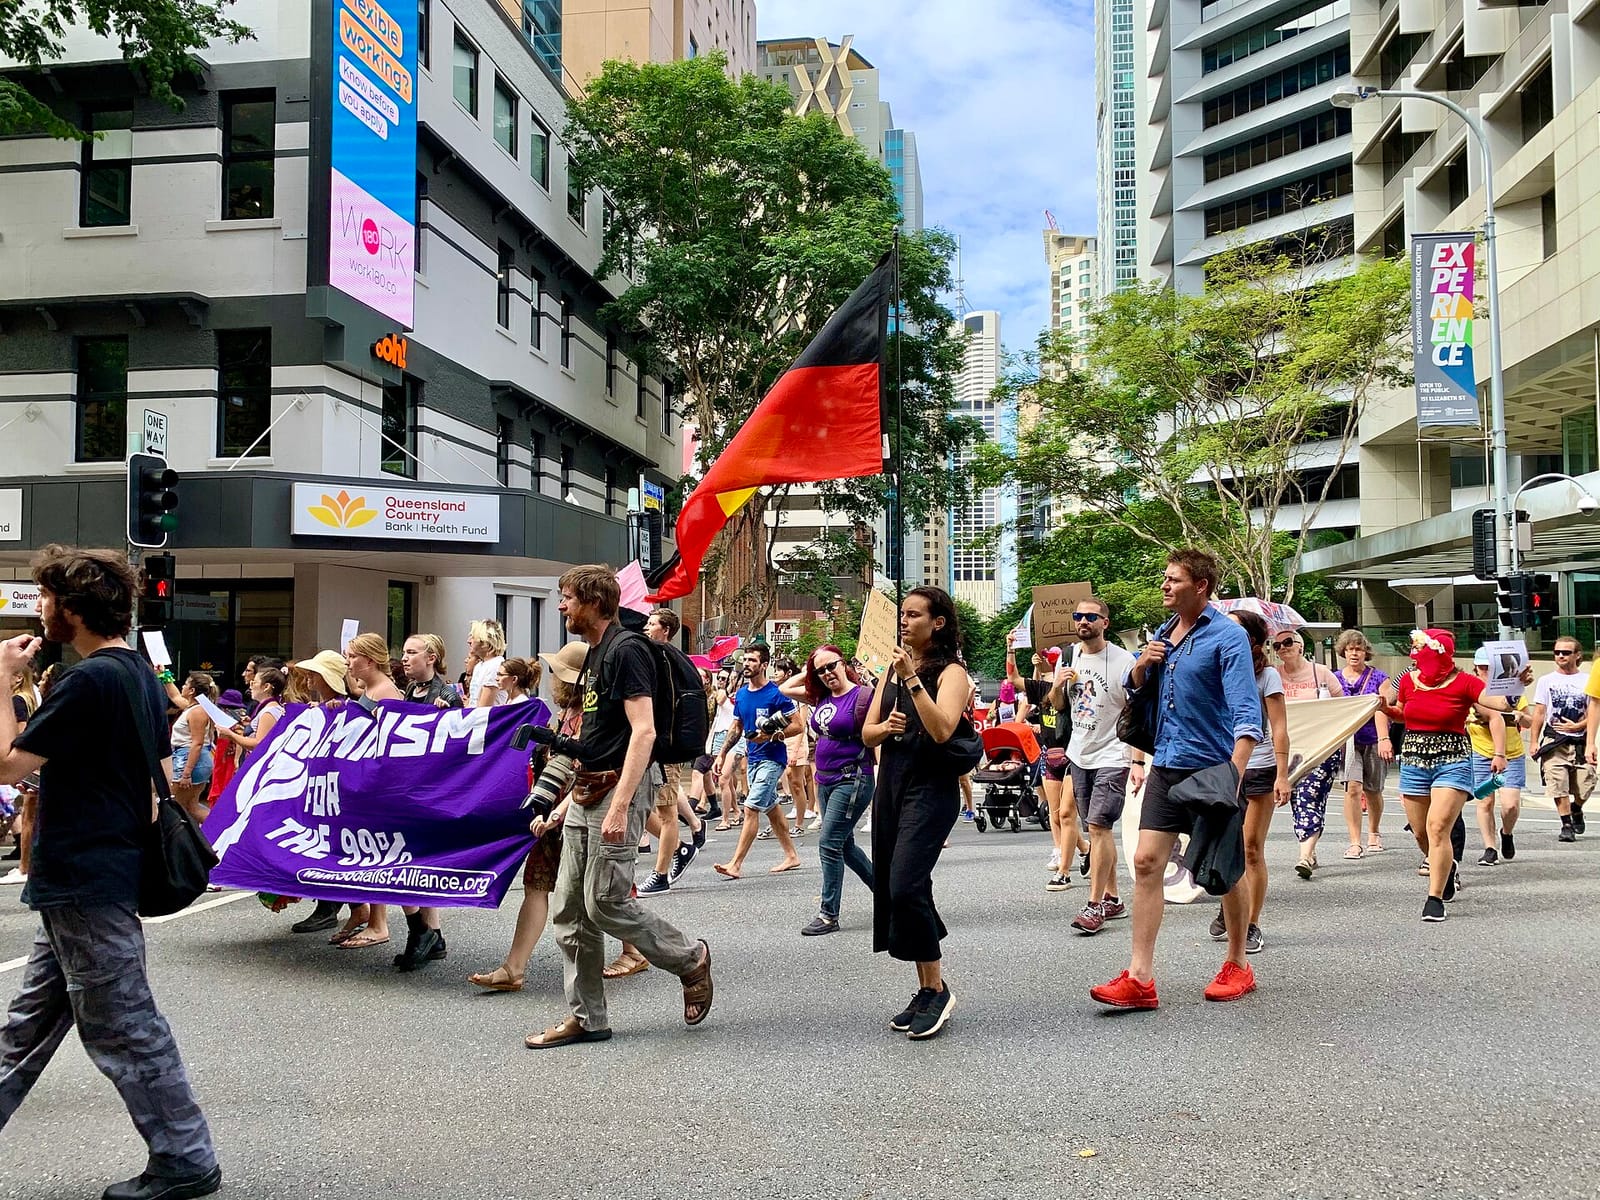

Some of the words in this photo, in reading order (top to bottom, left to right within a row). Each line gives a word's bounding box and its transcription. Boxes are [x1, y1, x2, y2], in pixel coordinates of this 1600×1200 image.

[354, 0, 398, 47] exible
[343, 20, 409, 95] working?
[342, 90, 359, 110] you
[360, 105, 385, 133] apply.
[369, 83, 395, 118] before
[1430, 242, 1471, 268] EX
[350, 258, 397, 295] work180.co
[1430, 267, 1468, 293] PE
[1430, 293, 1461, 318] RI
[1431, 318, 1468, 342] EN
[1432, 341, 1467, 367] CE
[147, 414, 164, 430] ONE
[146, 429, 165, 445] WAY
[385, 496, 466, 512] Queensland
[385, 509, 440, 524] Country
[385, 522, 413, 532] Bank
[421, 523, 458, 534] Health
[462, 525, 488, 535] Fund
[12, 591, 40, 600] Queen
[1040, 598, 1060, 608] WHO
[304, 771, 341, 817] FOR
[264, 817, 331, 859] THE
[337, 828, 413, 867] 99%
